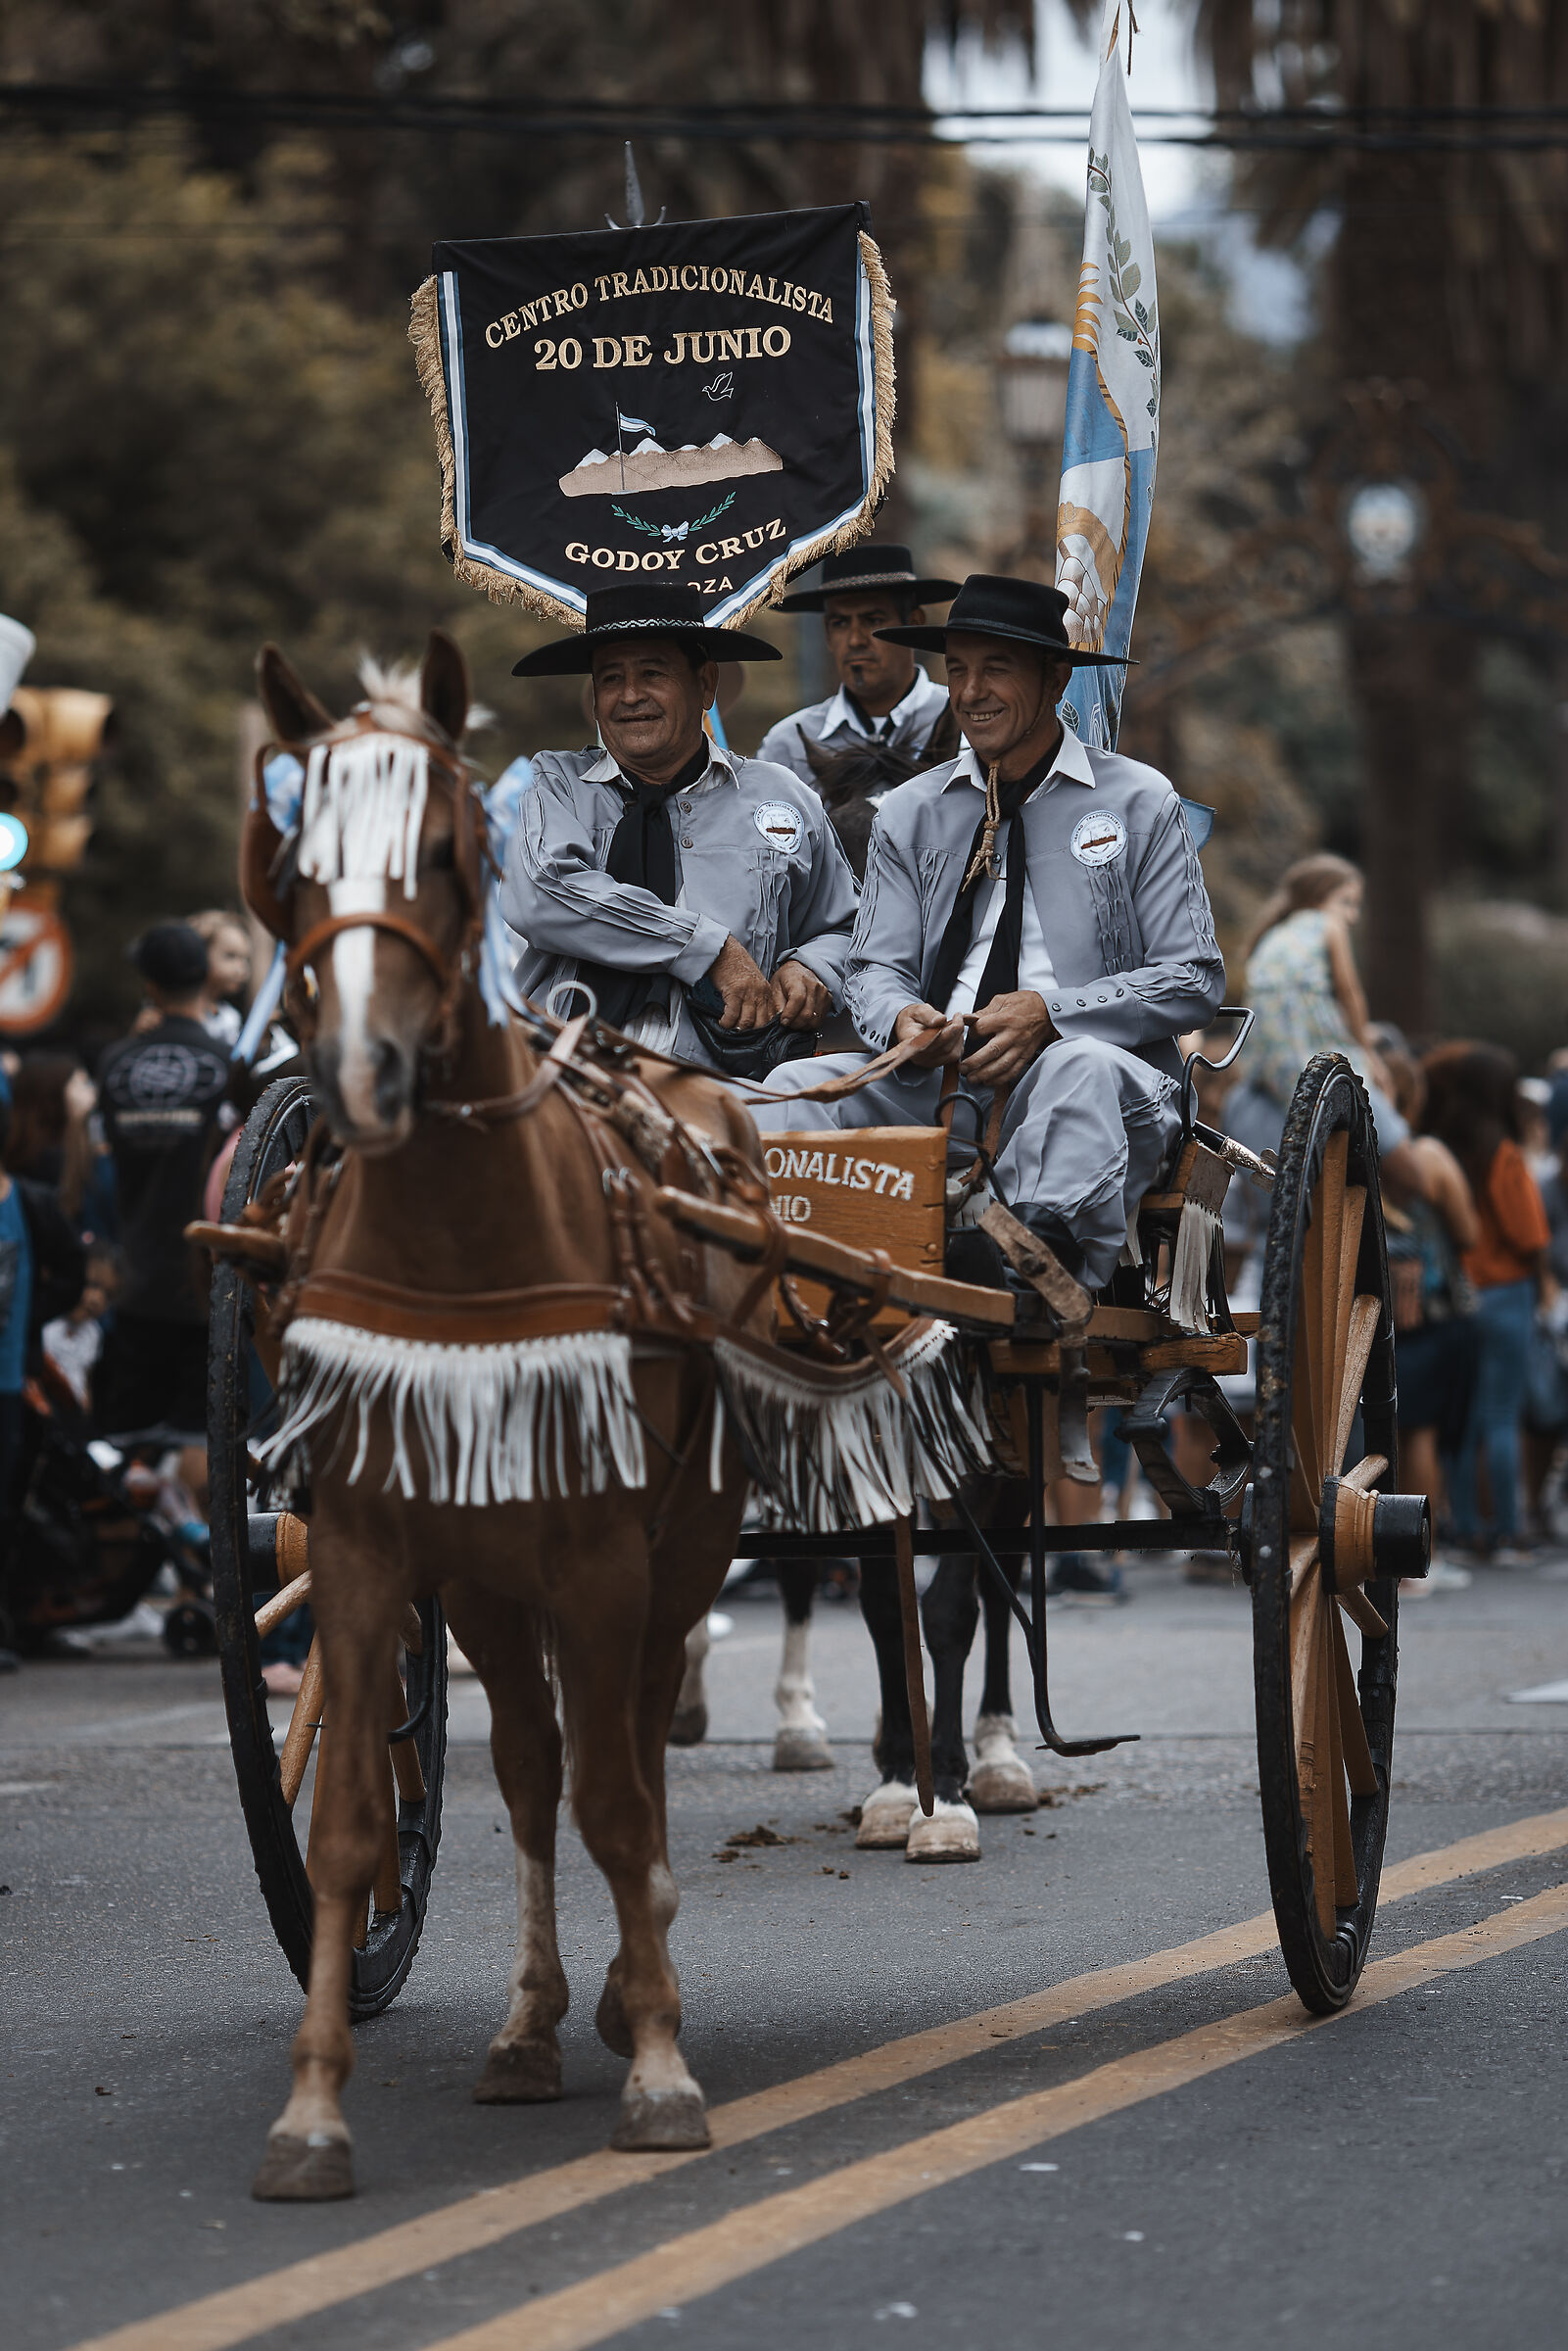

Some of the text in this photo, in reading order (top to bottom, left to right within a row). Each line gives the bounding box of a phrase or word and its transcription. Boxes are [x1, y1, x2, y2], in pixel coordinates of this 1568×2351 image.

[485, 264, 833, 349] CENTRO TRADICIONALISTA
[534, 325, 791, 370] 20 DE JUNIO
[564, 518, 786, 571] GODOY CRUZ
